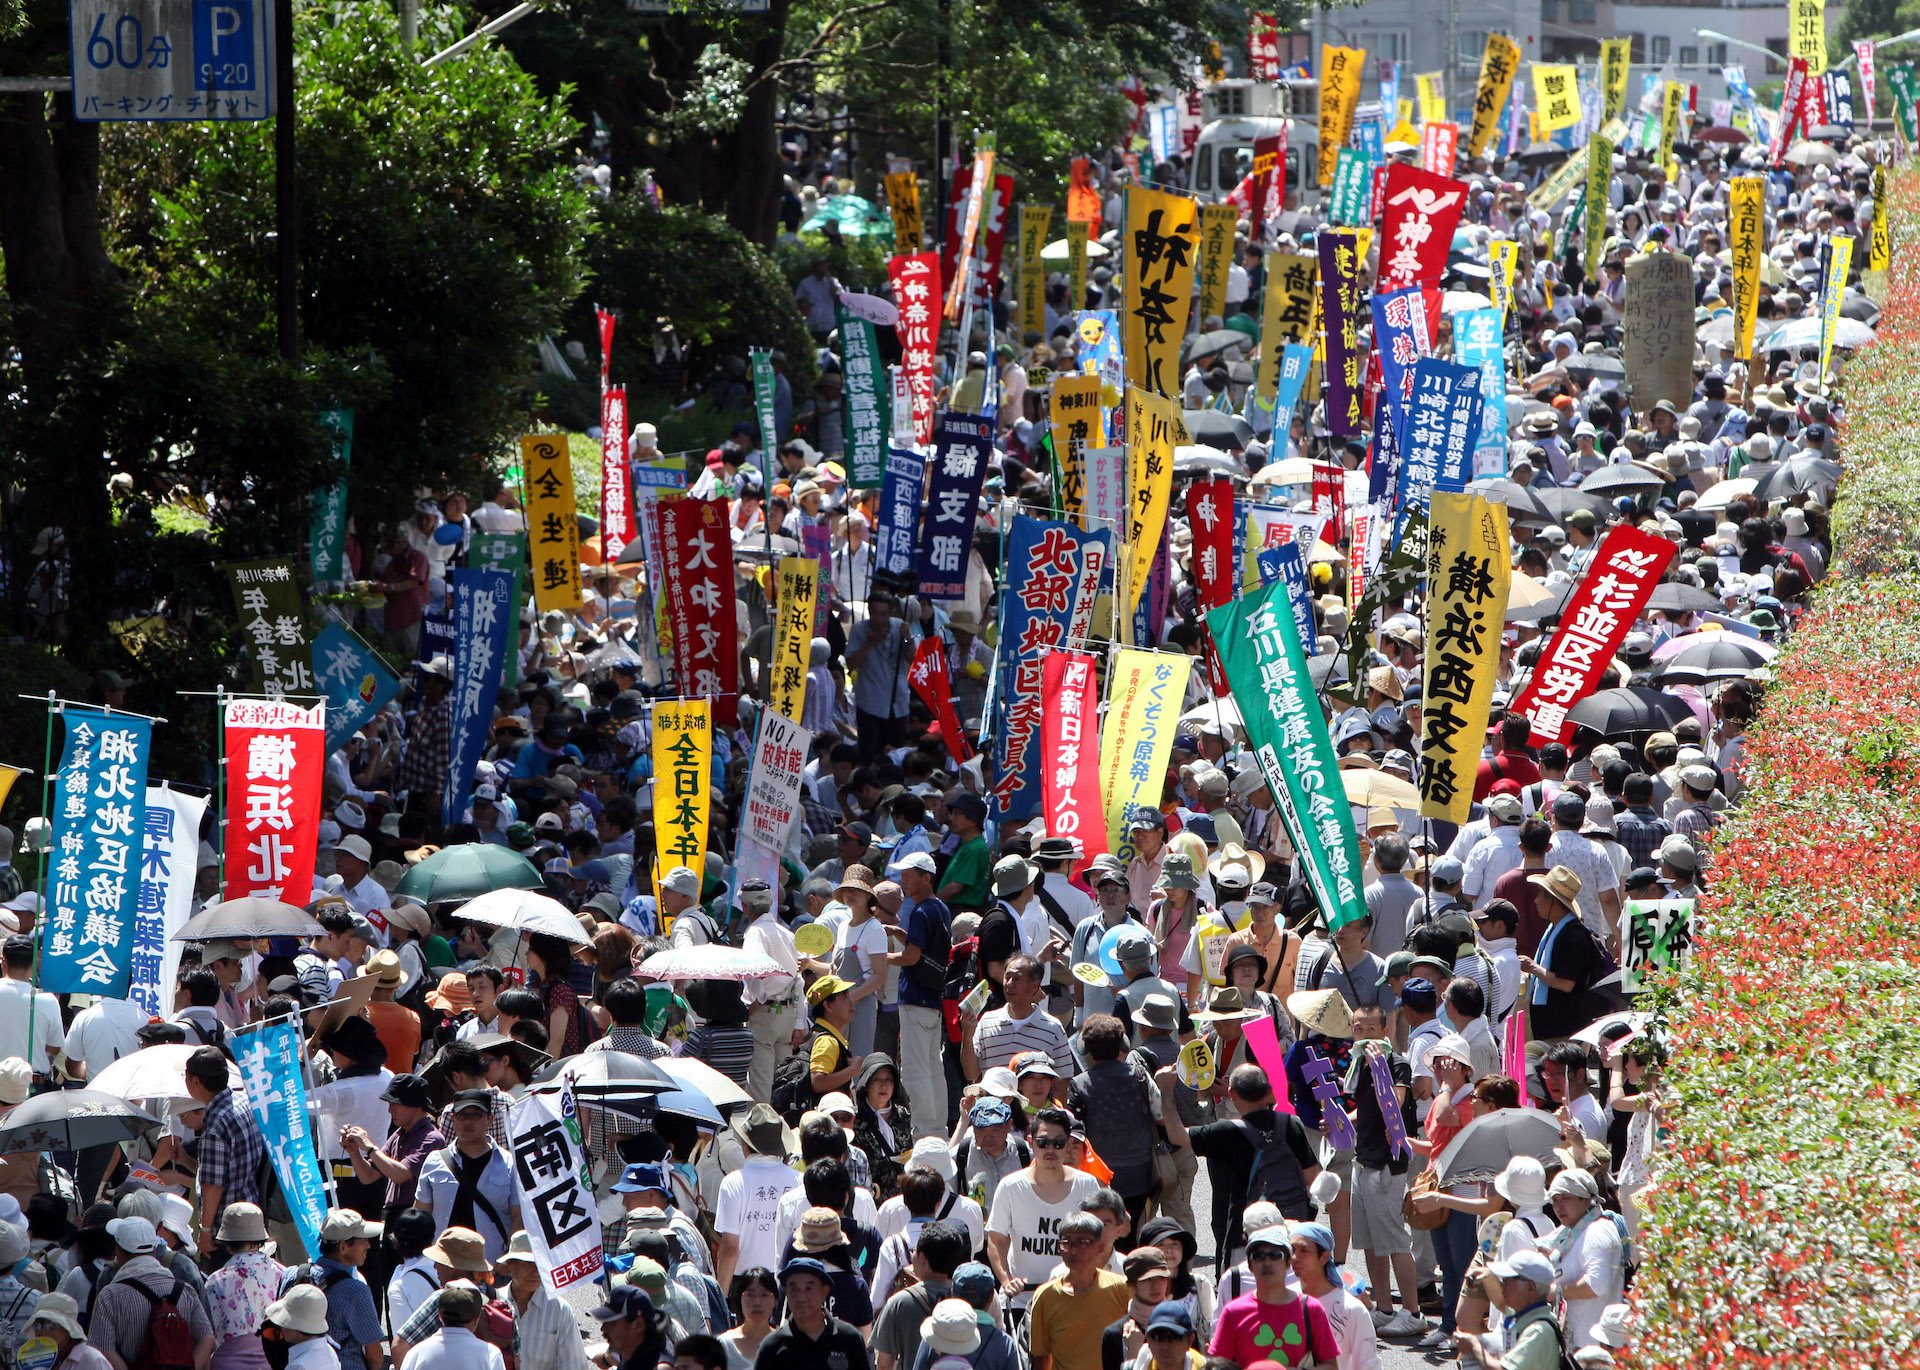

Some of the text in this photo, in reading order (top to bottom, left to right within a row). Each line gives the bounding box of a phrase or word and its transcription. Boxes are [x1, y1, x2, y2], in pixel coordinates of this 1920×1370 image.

[87, 13, 172, 70] 60分
[210, 7, 241, 56] P
[200, 64, 248, 85] 9-20
[83, 96, 259, 115] パーキング・チケット
[993, 530, 1081, 813] 北部地区委員会
[1524, 571, 1640, 741] 杉並区労連
[762, 741, 802, 774] 放射能
[1244, 600, 1359, 907] 石川県健康友の会連絡会
[1194, 1043, 1209, 1069] NO
[514, 1118, 593, 1250] 南区
